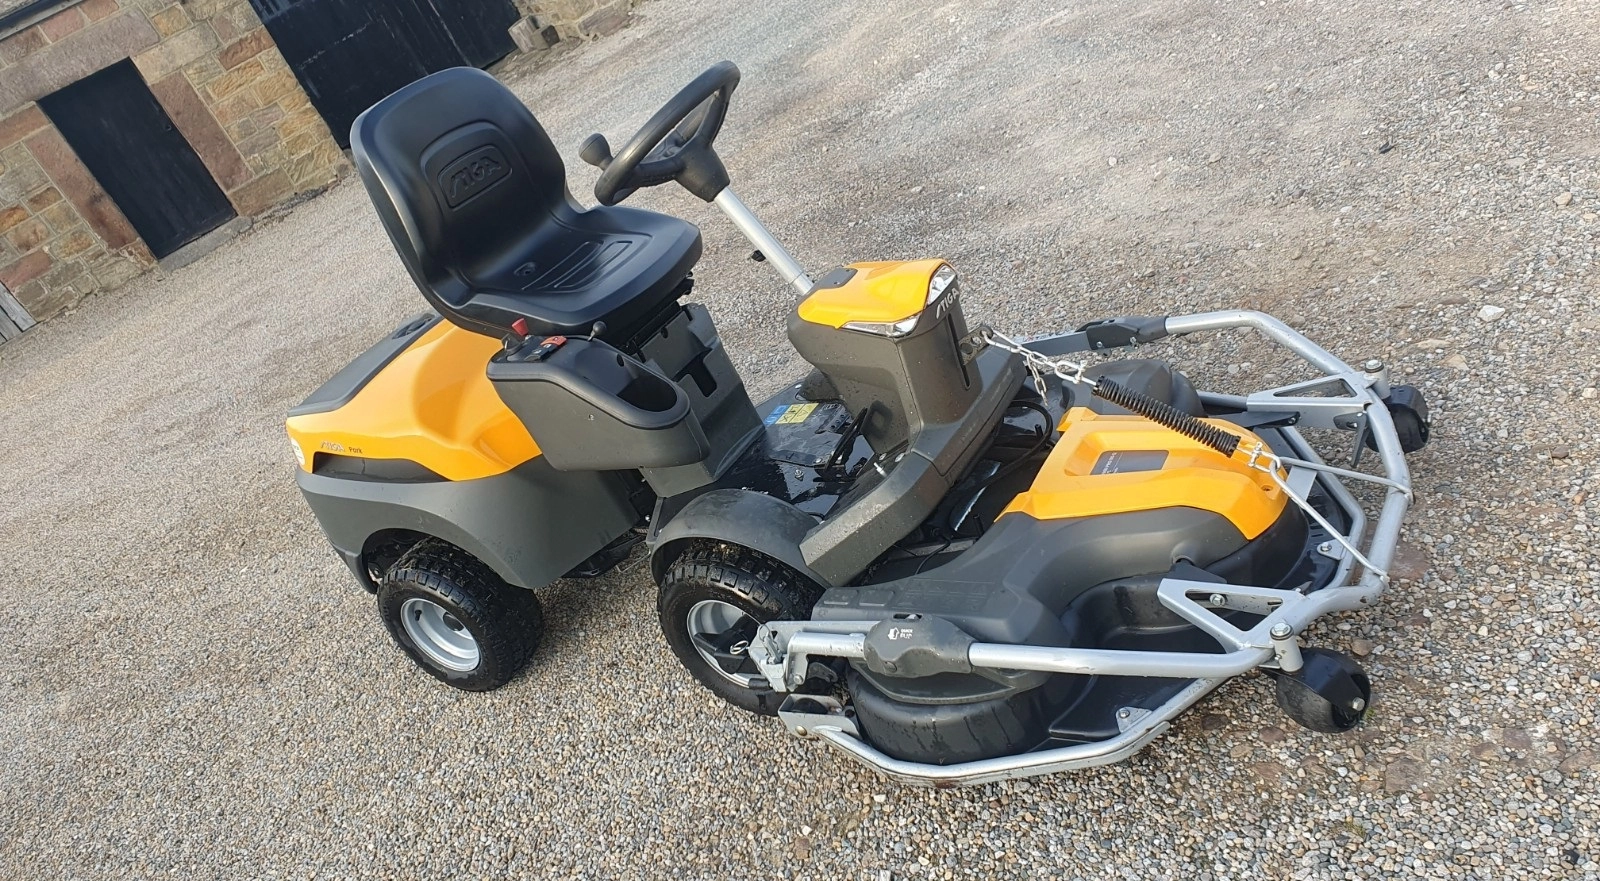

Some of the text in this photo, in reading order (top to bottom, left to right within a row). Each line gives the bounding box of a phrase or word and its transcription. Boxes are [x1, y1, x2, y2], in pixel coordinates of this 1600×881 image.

[450, 156, 501, 198] STIGA
[936, 287, 960, 319] STIGA
[348, 446, 363, 454] Park
